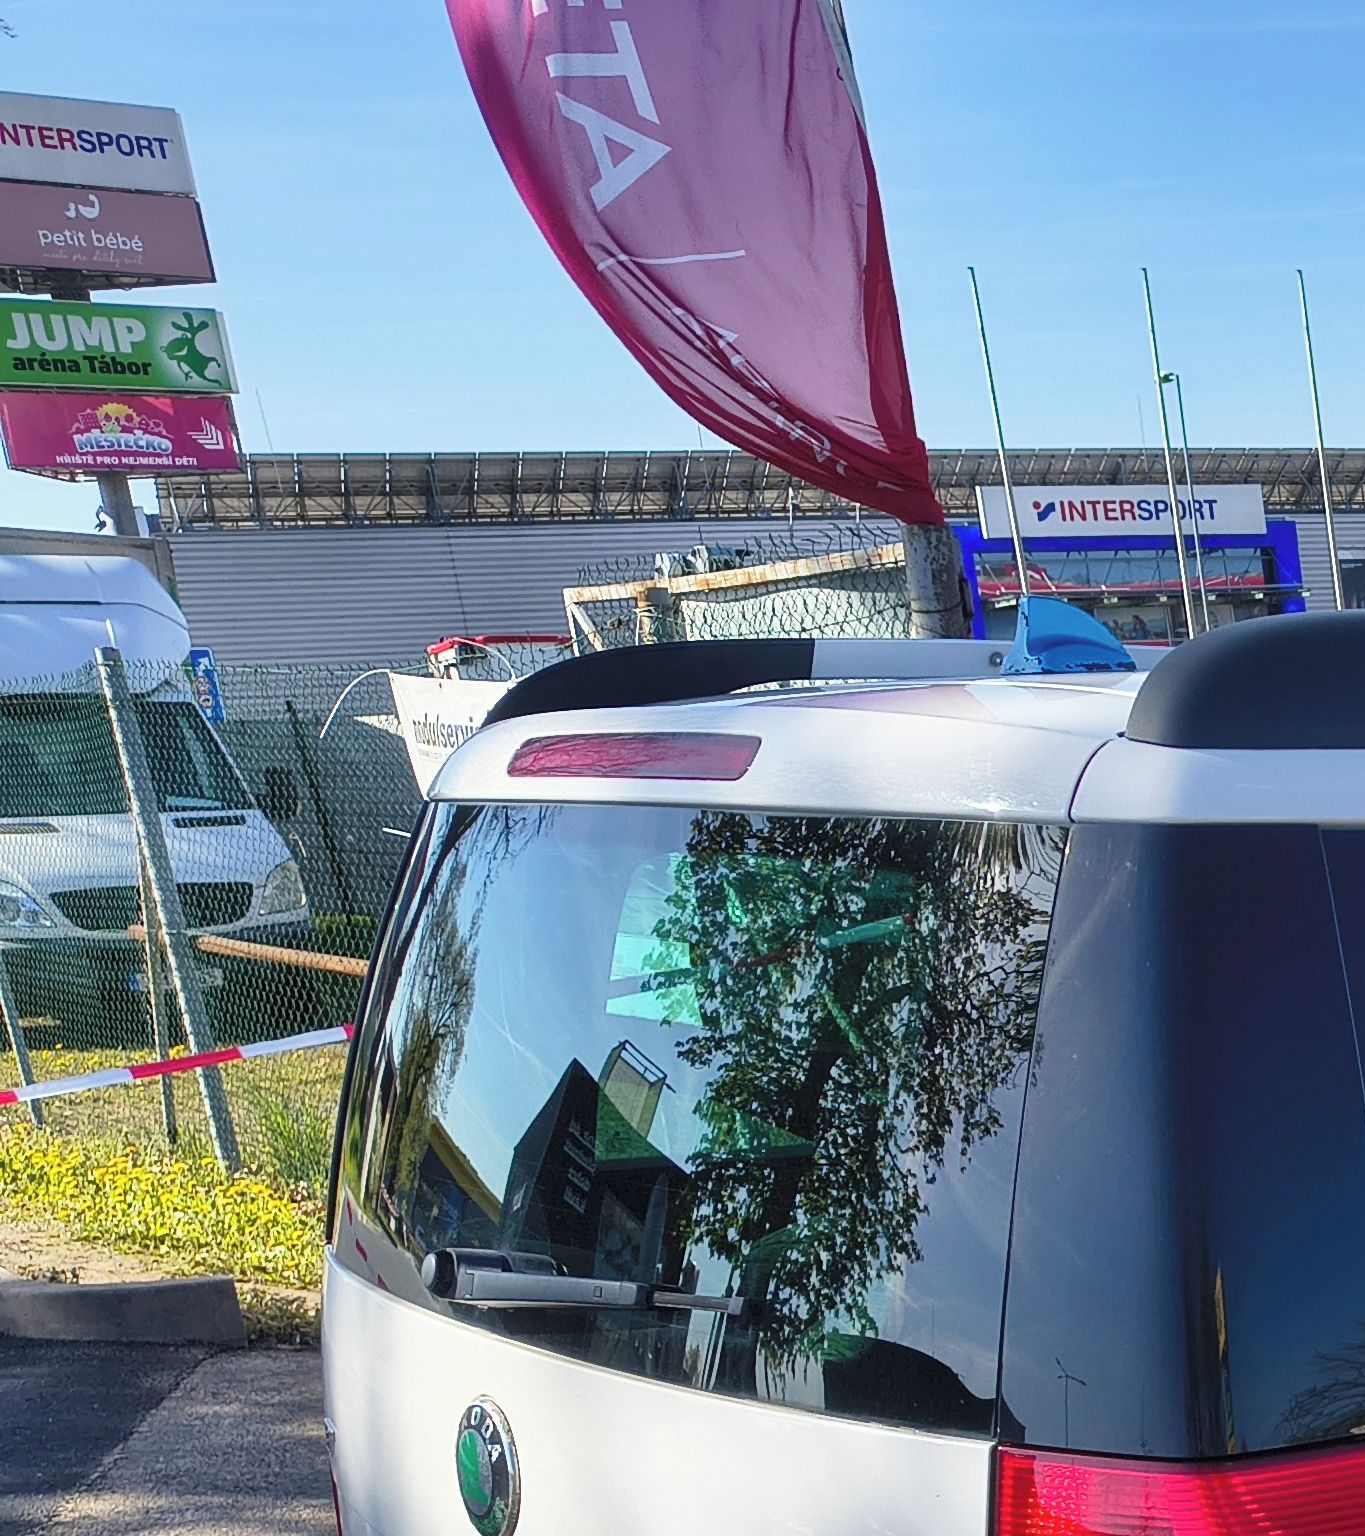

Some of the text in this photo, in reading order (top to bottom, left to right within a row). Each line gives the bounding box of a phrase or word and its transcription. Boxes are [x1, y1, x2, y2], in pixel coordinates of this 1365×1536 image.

[531, 0, 673, 213] TA
[38, 228, 143, 252] petit bébé
[6, 311, 147, 354] JUMP
[13, 352, 152, 376] aréna Tábor
[73, 429, 173, 454] MĚSTEČKO
[97, 455, 119, 466] PRO
[121, 454, 173, 467] NEJMENŠÍ
[175, 454, 198, 467] DĚTI
[1059, 499, 1218, 522] INTERSPORT
